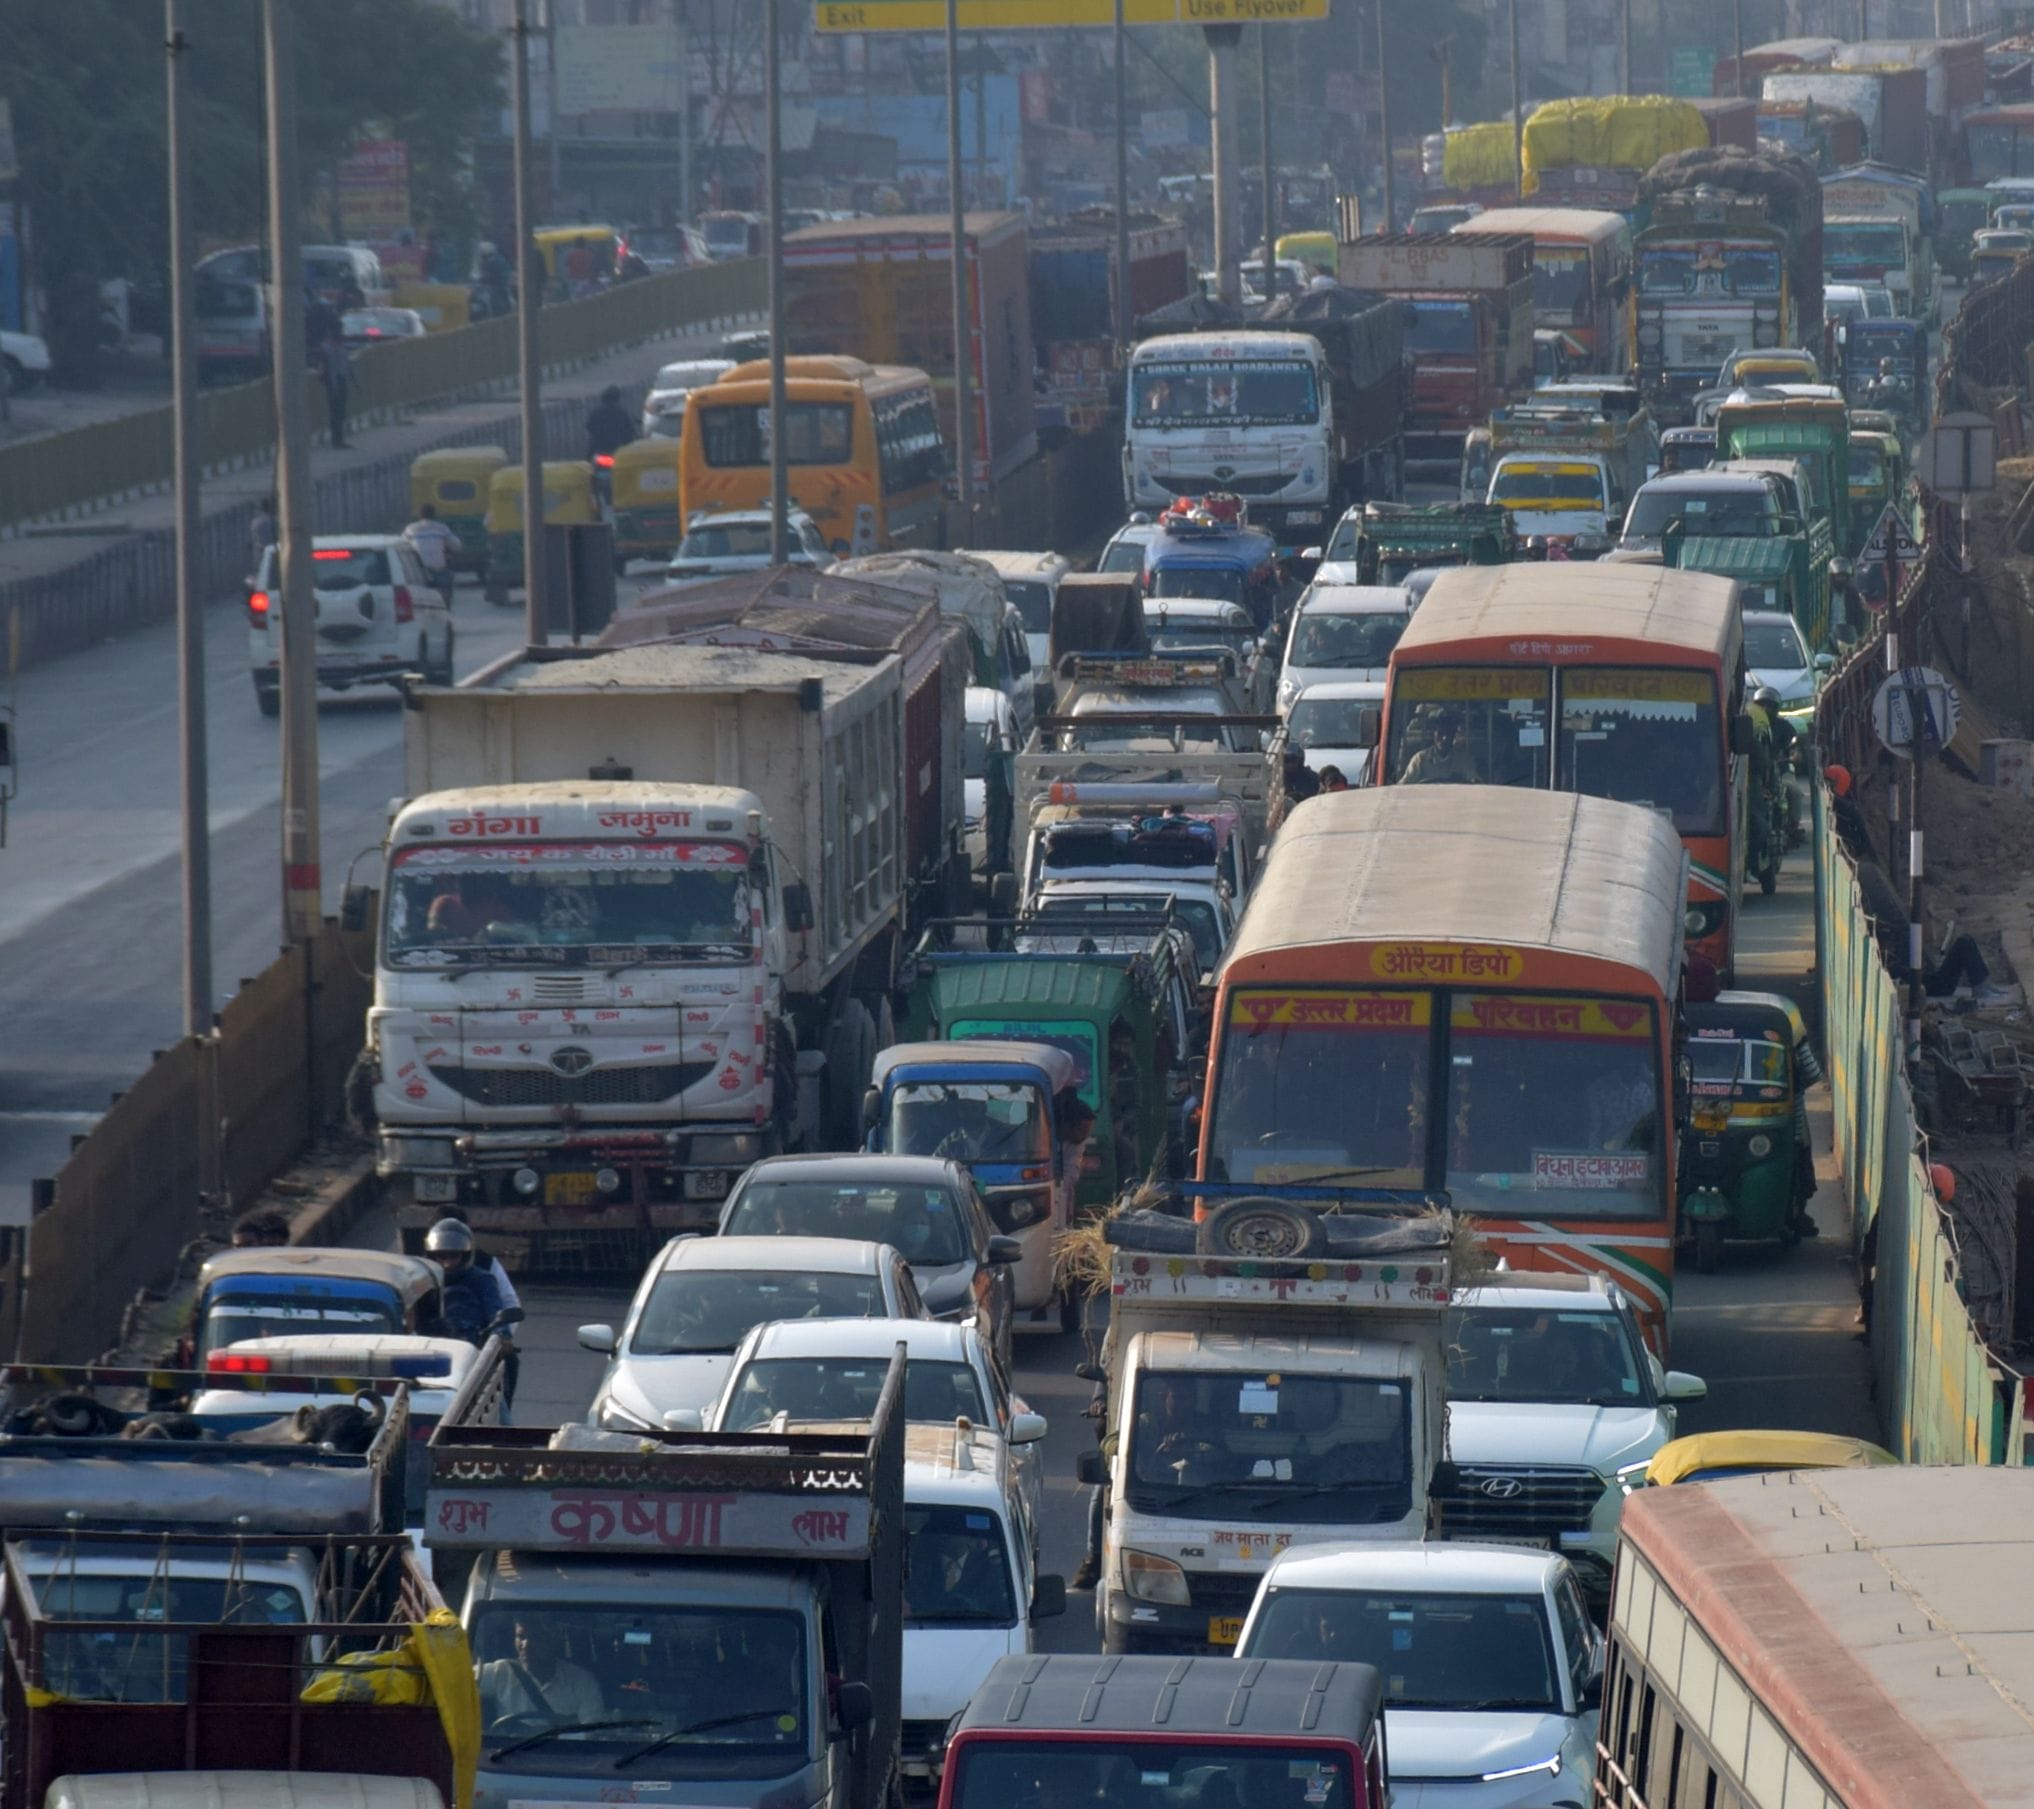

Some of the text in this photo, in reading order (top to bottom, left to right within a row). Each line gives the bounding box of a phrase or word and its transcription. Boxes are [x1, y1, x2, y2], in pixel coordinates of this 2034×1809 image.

[826, 5, 865, 26] Exit
[1188, 0, 1307, 17] Use Flyover
[447, 811, 692, 837] गंगा जमुना
[1460, 948, 1512, 976] डिपो
[1290, 991, 1415, 1023] उत्तर प्रदेश
[1471, 996, 1586, 1031] परिवहन
[438, 1499, 492, 1534] शुभ
[792, 1509, 850, 1546] लाभ
[1180, 1547, 1205, 1557] ACE
